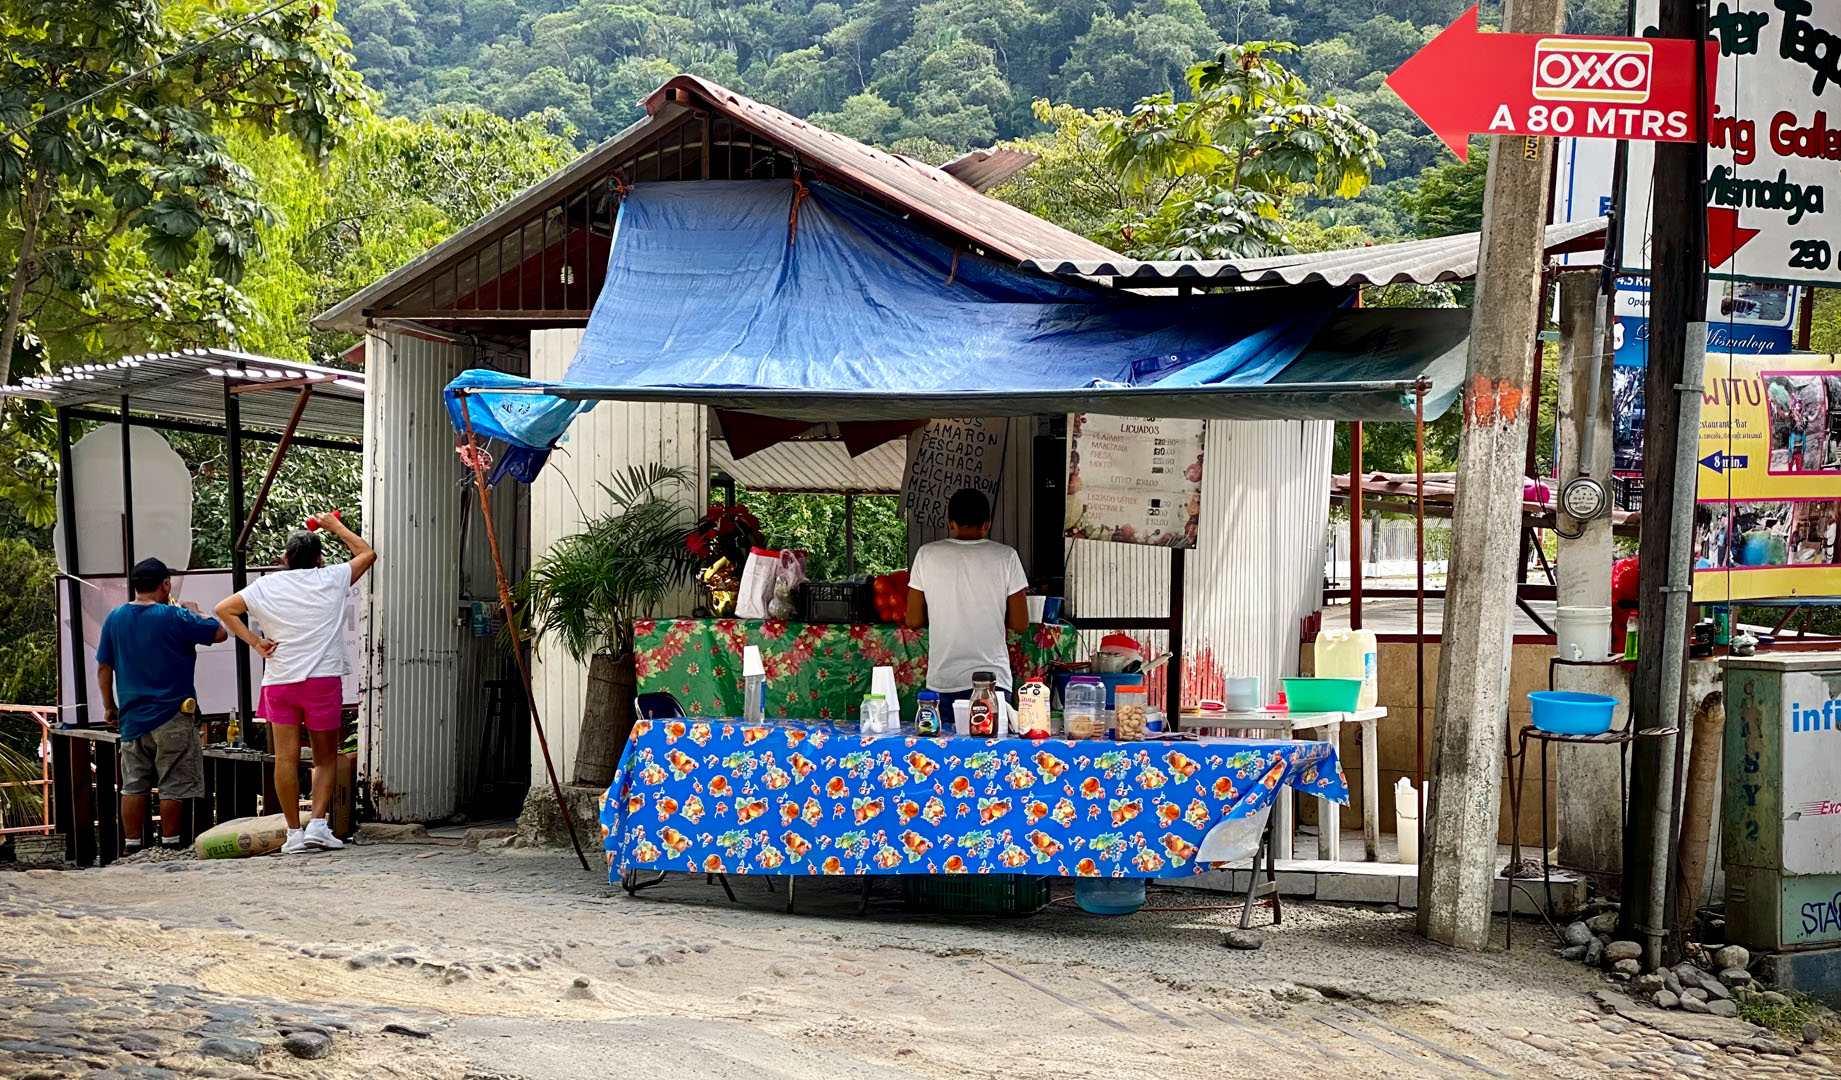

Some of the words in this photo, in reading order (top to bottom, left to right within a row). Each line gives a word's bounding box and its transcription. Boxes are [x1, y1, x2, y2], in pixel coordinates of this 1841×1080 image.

[1539, 53, 1646, 88] OXXO
[1489, 104, 1516, 131] A
[1527, 105, 1575, 132] 80
[1586, 107, 1687, 138] MTRS
[1525, 136, 1538, 160] 52
[1788, 239, 1832, 270] 250
[1702, 377, 1761, 407] WITU
[1120, 423, 1160, 435] LICUADOS
[920, 433, 984, 458] PESCADO
[916, 447, 983, 474] MACHACA
[1713, 456, 1720, 468] 8
[908, 474, 953, 501] MEXIC
[913, 508, 945, 528] LENG
